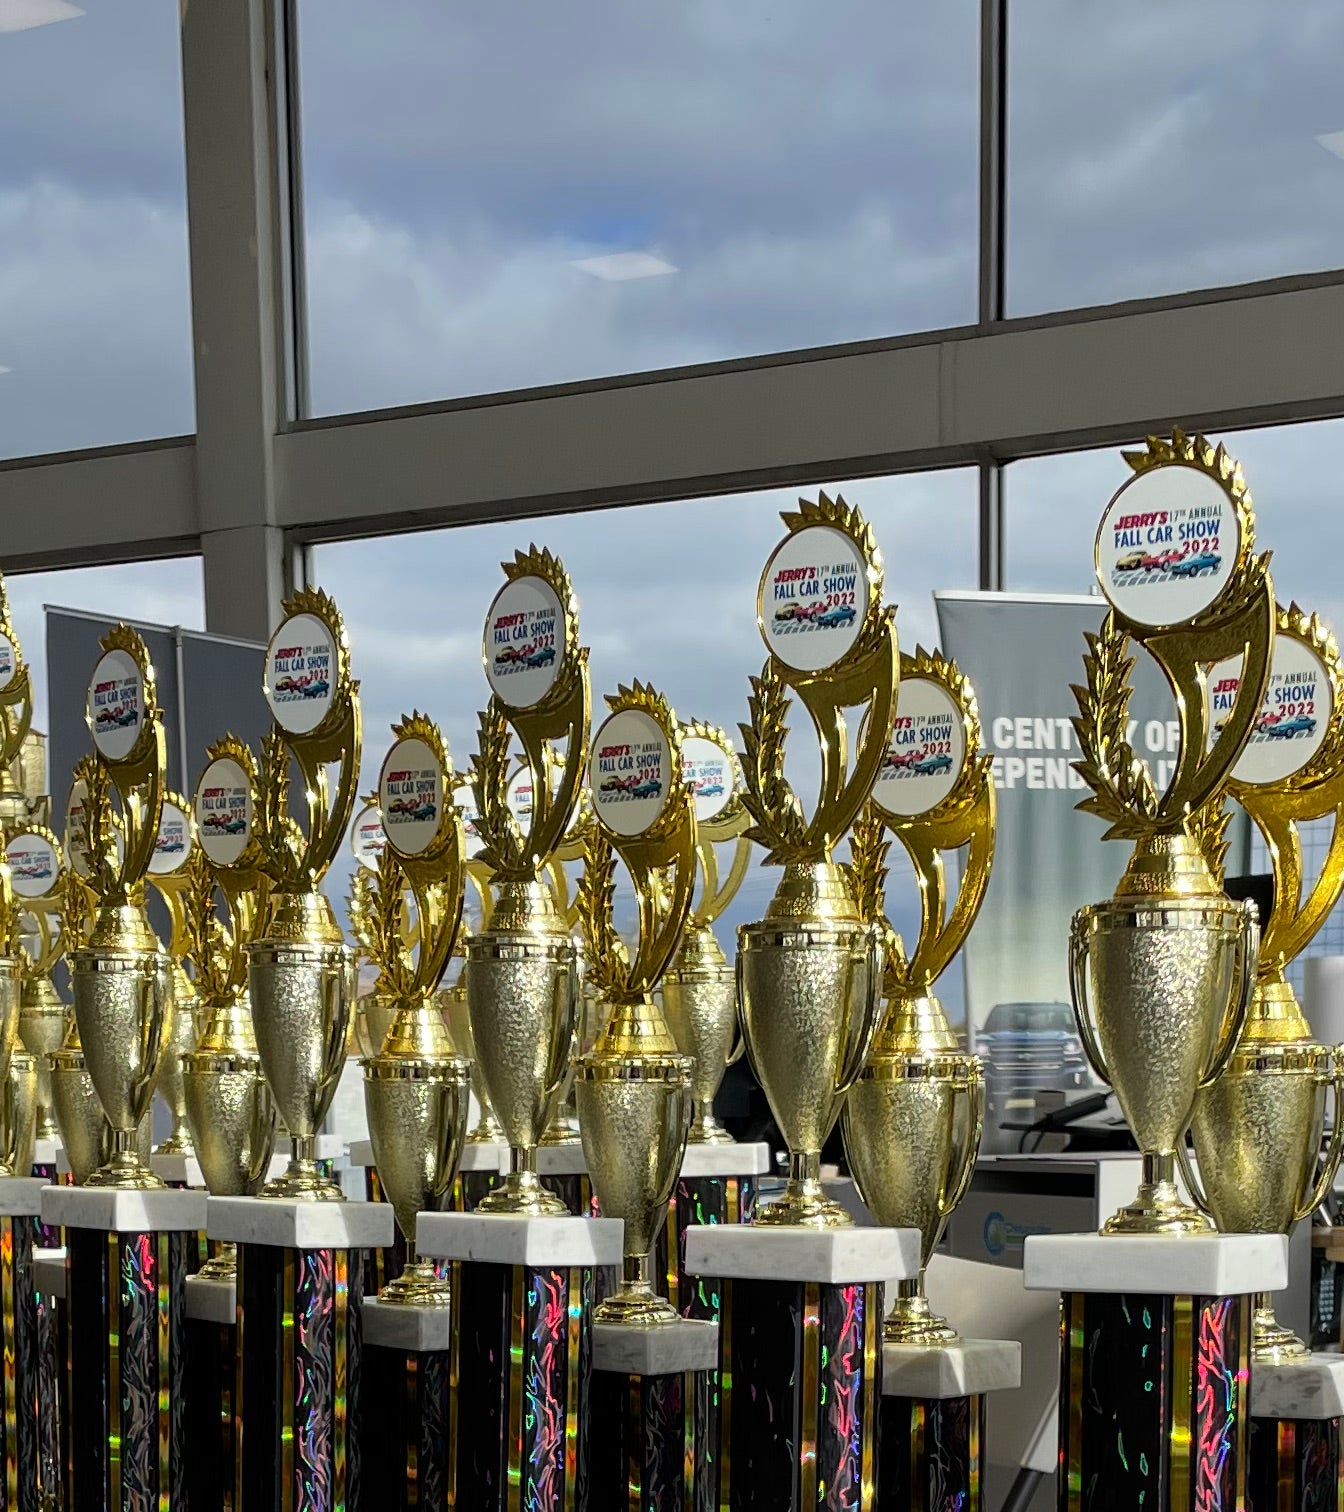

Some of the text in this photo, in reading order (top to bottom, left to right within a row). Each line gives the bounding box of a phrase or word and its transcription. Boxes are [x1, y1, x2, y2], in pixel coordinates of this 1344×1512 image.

[1114, 511, 1168, 530] JERRY'S
[1189, 504, 1222, 520] ANNUAL
[1115, 520, 1220, 549] FALL CAR SHOW
[1183, 537, 1219, 554] 2022
[774, 566, 816, 583] JERRY'S
[775, 575, 856, 600] FALL CAR SHOW
[826, 592, 854, 606] 2022
[495, 619, 555, 644] FALL CAR SHOW
[534, 634, 554, 648] 2022
[275, 655, 329, 673] FALL CAR SHOW
[310, 669, 328, 680] 2022
[1285, 671, 1317, 684] ANNUAL
[1275, 685, 1315, 703] SHOW
[1279, 702, 1314, 716] 2022
[896, 726, 951, 744] CAR SHOW
[923, 741, 951, 754] 2022
[600, 753, 661, 772] FALL CAR SHOW
[639, 769, 660, 779] 2022
[402, 782, 414, 794] CAR
[417, 780, 435, 793] SHOW
